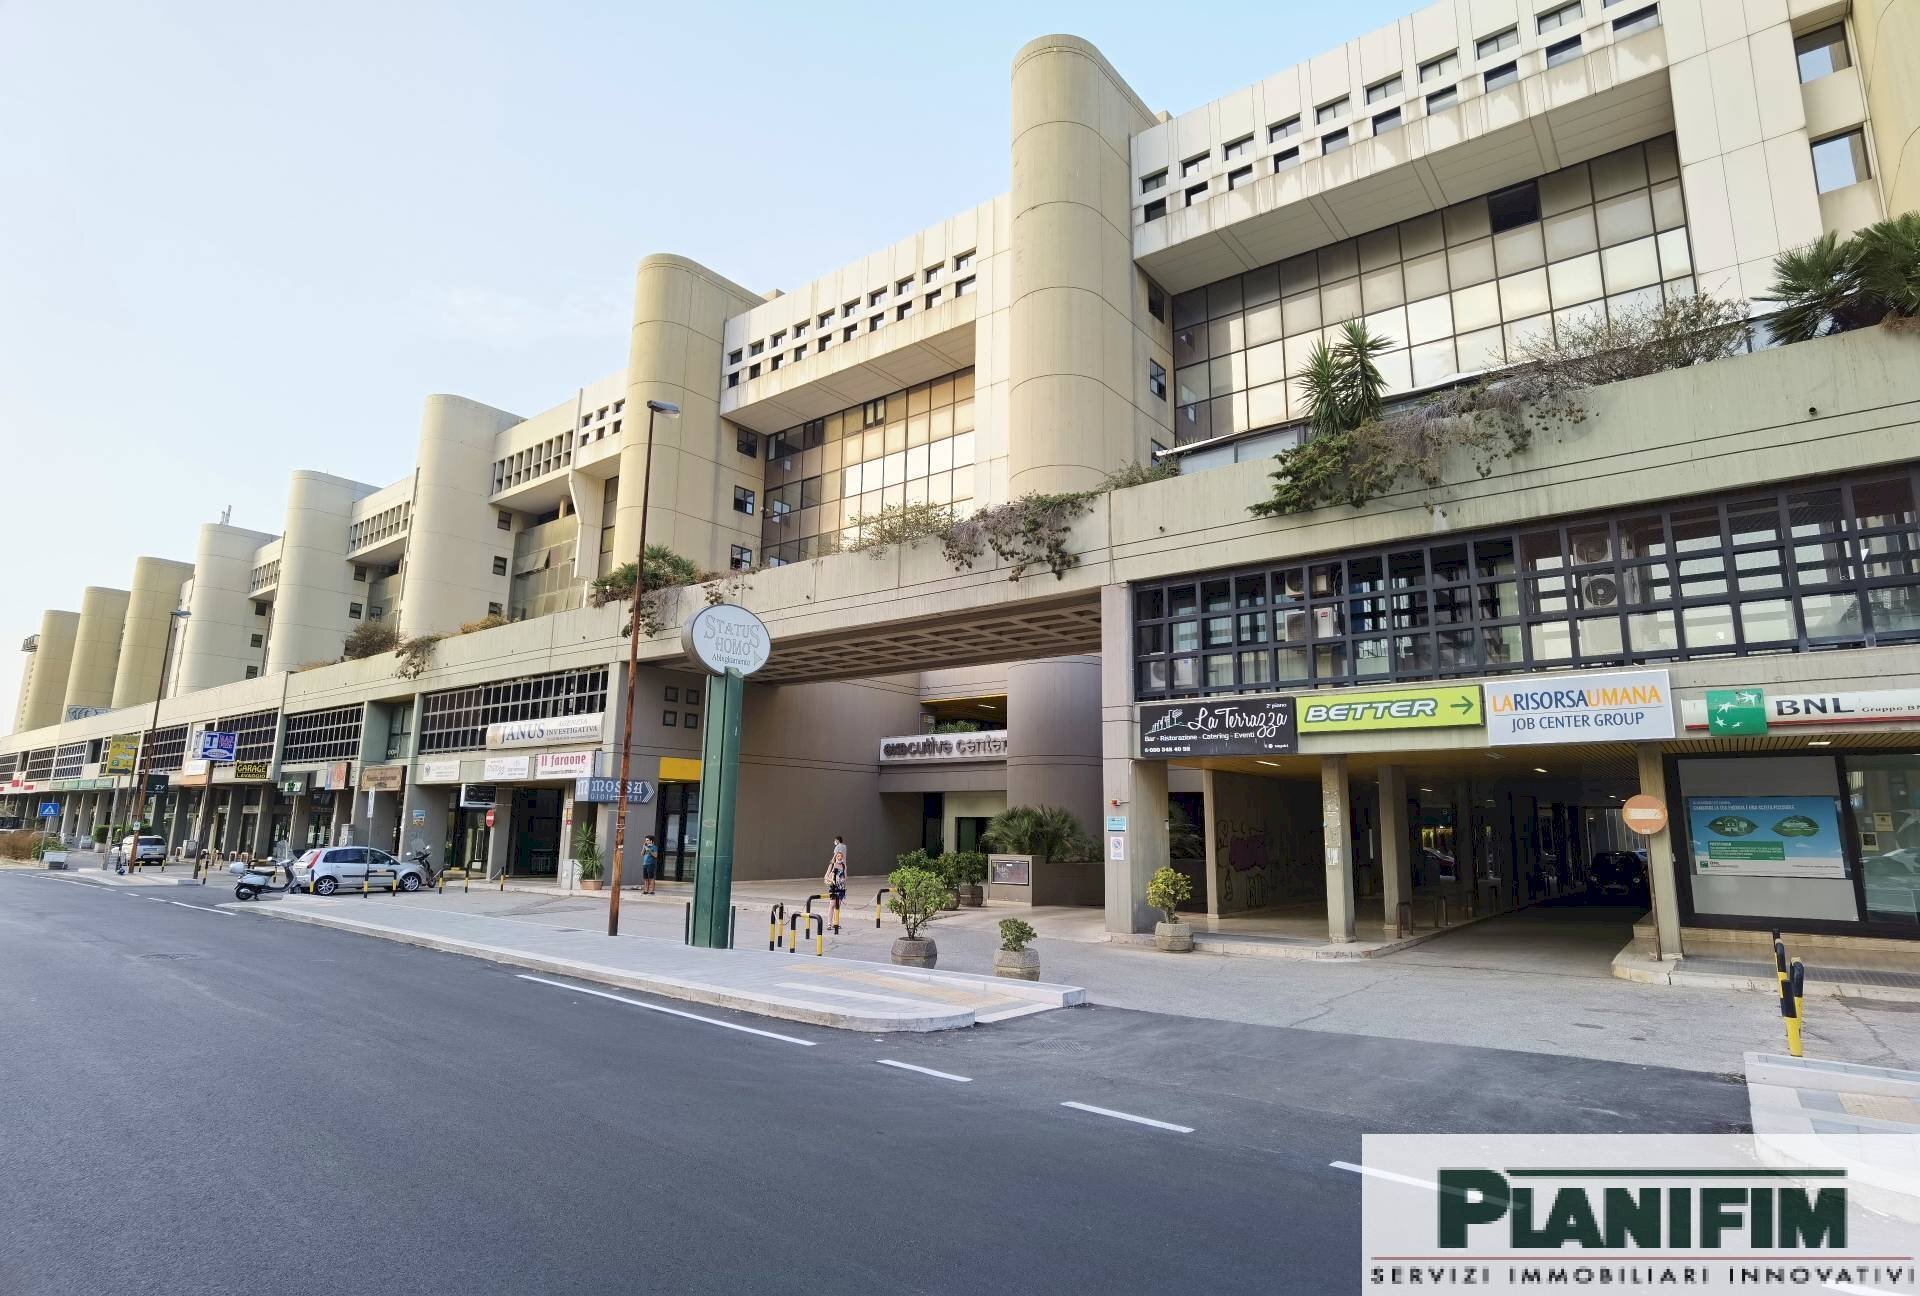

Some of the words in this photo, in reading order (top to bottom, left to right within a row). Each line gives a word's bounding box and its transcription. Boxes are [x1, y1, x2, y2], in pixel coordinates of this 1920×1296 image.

[704, 615, 760, 648] STATUS
[715, 637, 751, 656] HOMO
[1305, 699, 1437, 722] BETTER
[1776, 697, 1855, 716] BNL
[546, 725, 598, 737] INVESTIGATIVA
[1188, 707, 1219, 731] La
[1215, 707, 1288, 738] Terrazza
[1512, 717, 1535, 732] JOB
[1539, 714, 1590, 729] CENTER
[1594, 712, 1645, 727] GROUP
[501, 722, 545, 744] JANUS
[1160, 734, 1198, 742] Ristorazione
[1202, 732, 1229, 740] Catering
[1234, 731, 1255, 739] Eventi
[883, 737, 953, 757] executive
[237, 764, 266, 773] GARAGE
[550, 754, 586, 767] faraone
